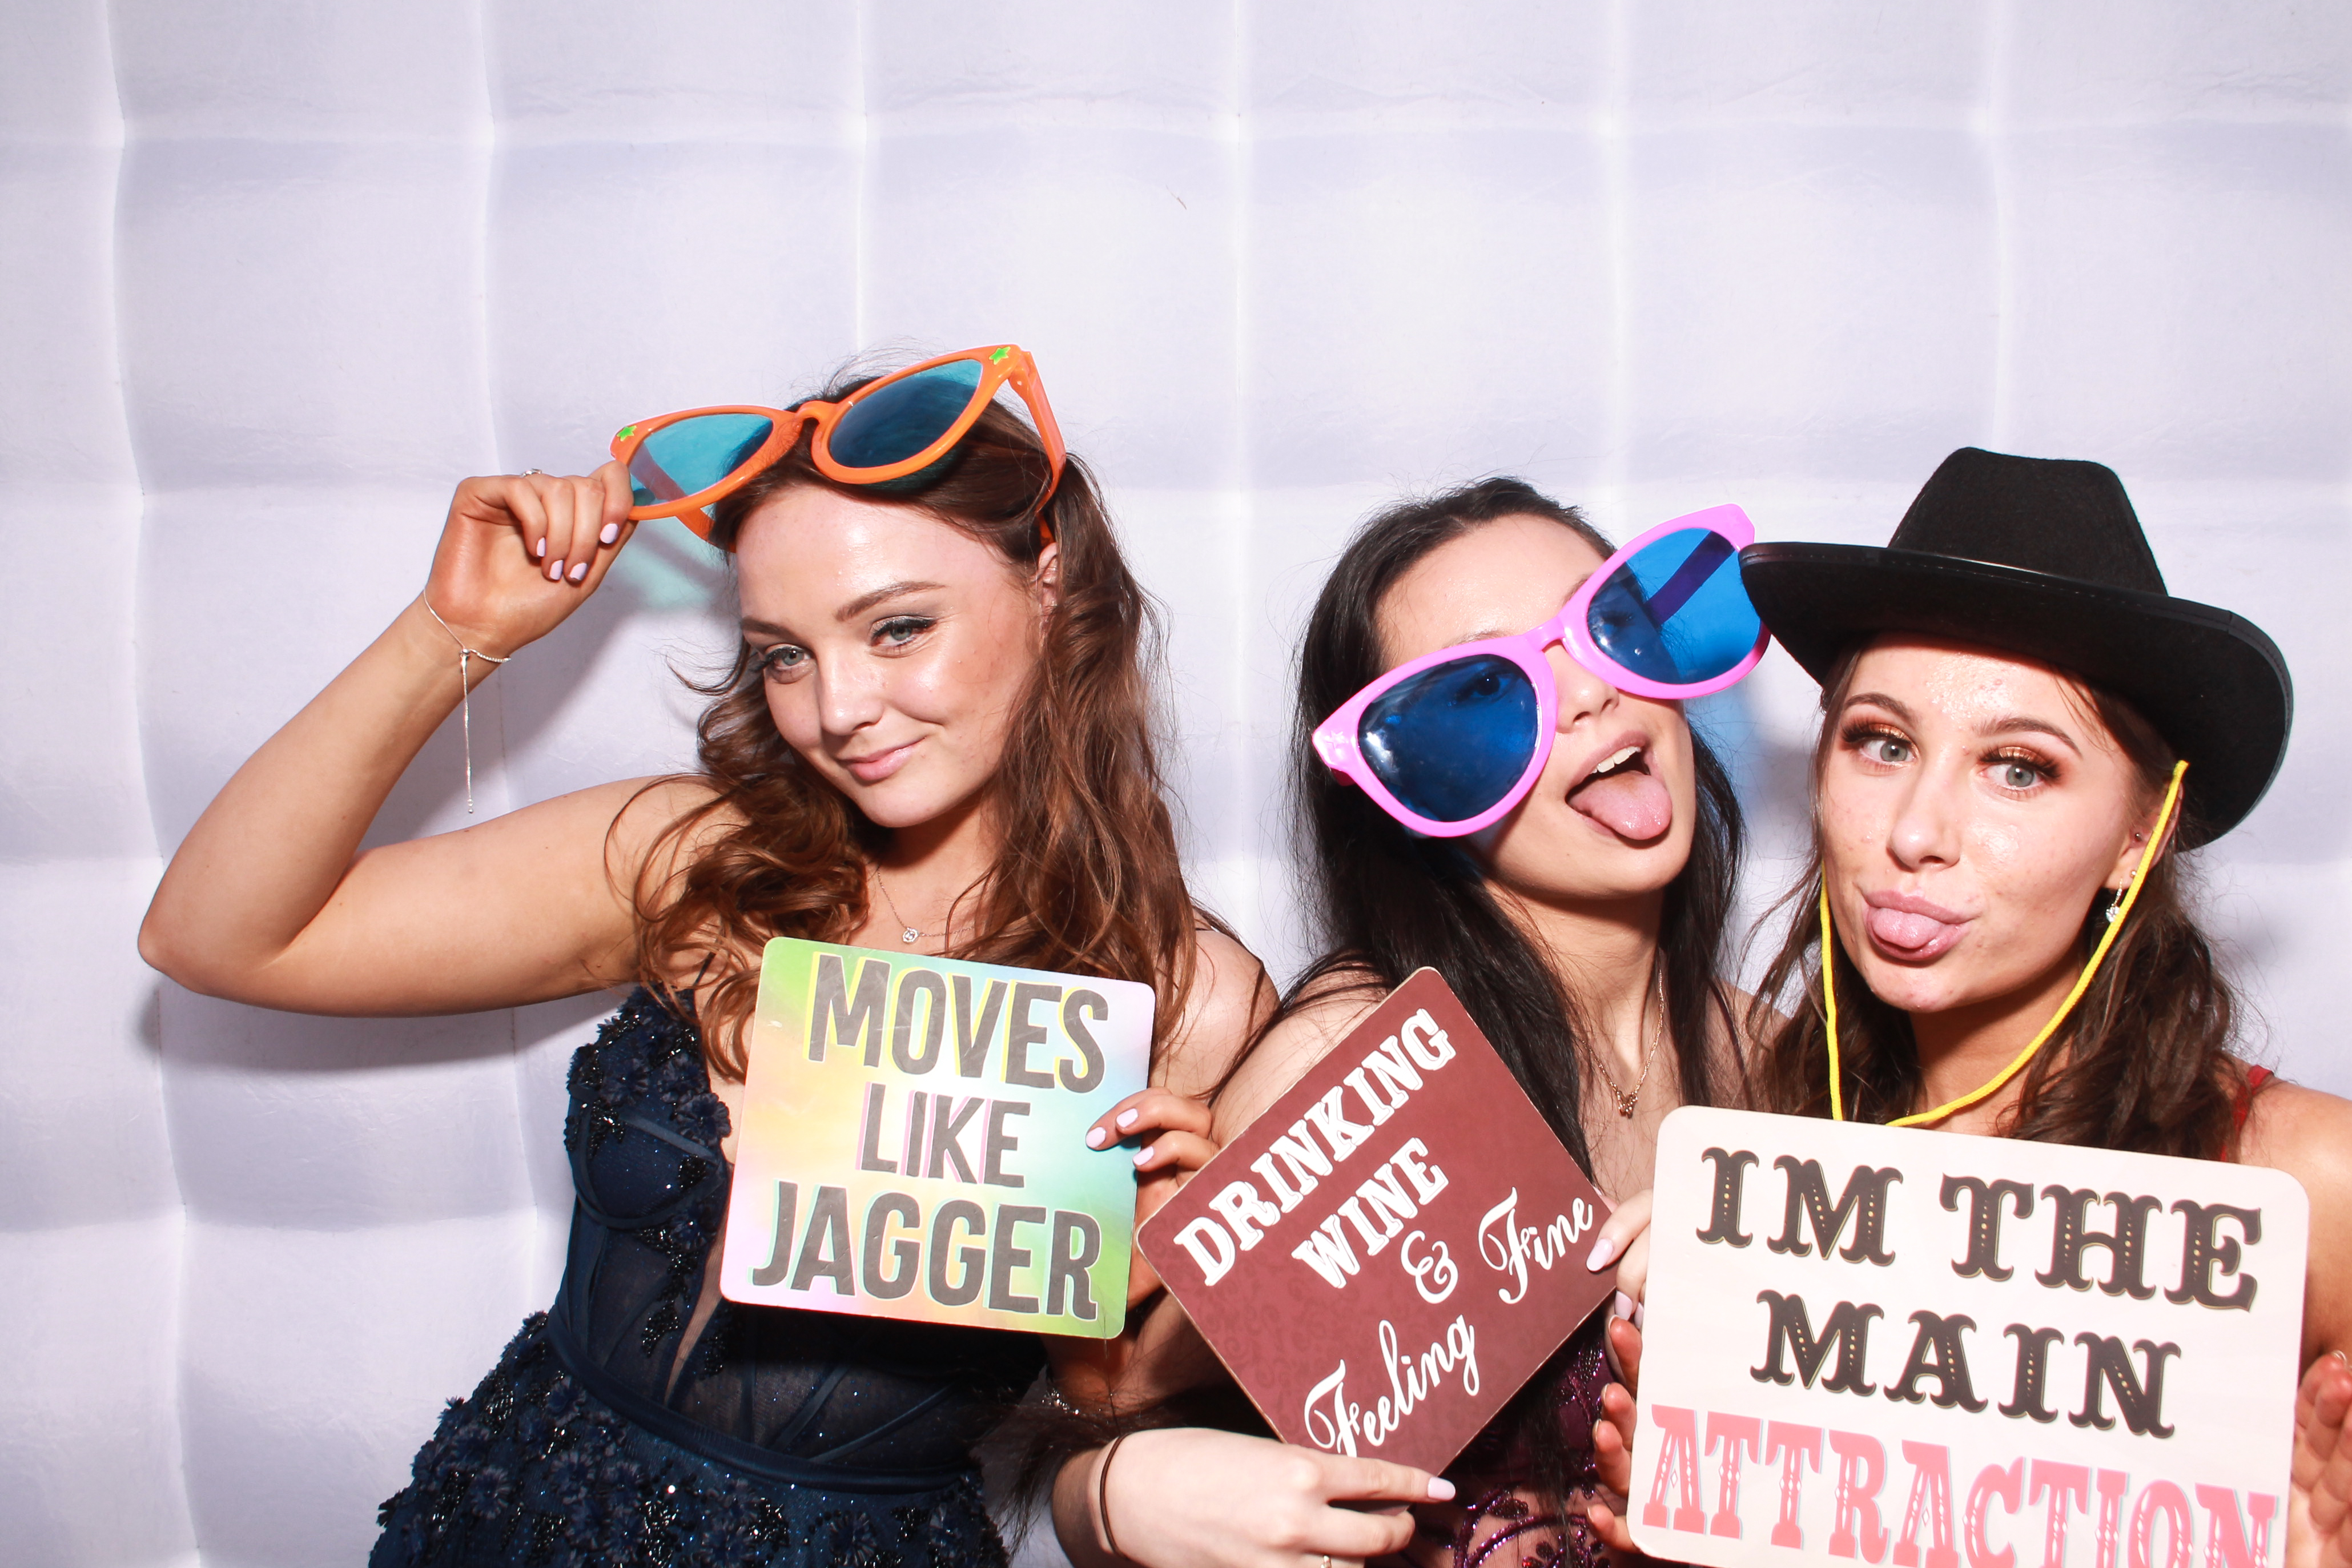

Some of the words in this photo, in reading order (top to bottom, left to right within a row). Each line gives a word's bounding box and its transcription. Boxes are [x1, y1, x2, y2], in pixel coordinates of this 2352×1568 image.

[803, 951, 1109, 1094] MOVES
[855, 1081, 1031, 1188] LIKE
[1173, 1008, 1457, 1286] DRINKING
[747, 1179, 1102, 1321] JAGGER
[1291, 1137, 1449, 1289] WINE
[1400, 1229, 1459, 1304] &
[1696, 1146, 1903, 1266] IM
[1940, 1172, 2262, 1312] THE
[1304, 1314, 1480, 1458] Feeling
[1477, 1186, 1594, 1304] Fine
[1750, 1289, 2181, 1438] MAIN
[1642, 1404, 2279, 1568] ATTRACTION
